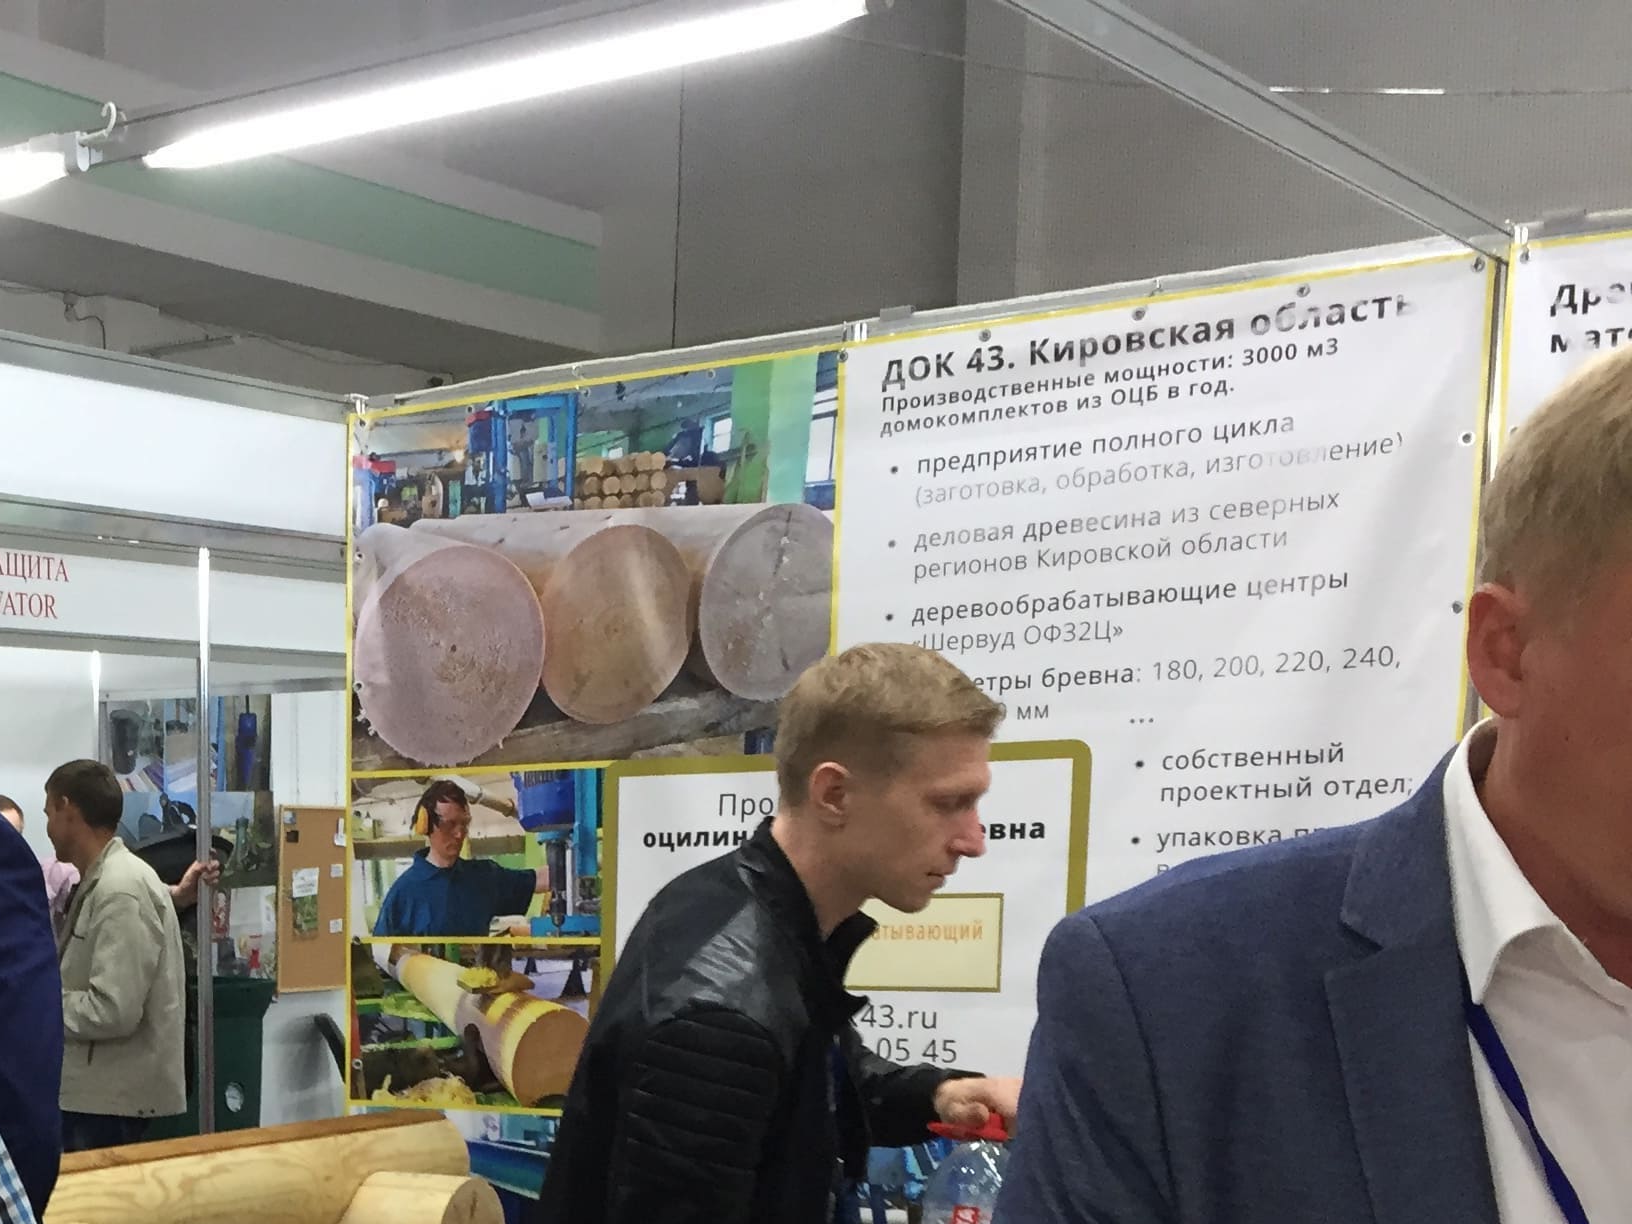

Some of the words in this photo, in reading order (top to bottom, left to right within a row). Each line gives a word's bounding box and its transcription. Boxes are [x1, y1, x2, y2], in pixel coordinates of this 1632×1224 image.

[881, 351, 955, 392] ДОК
[967, 345, 1016, 373] 43.
[1029, 317, 1235, 367] Кировская
[882, 372, 1096, 414] Производственные
[1104, 352, 1233, 384] мощности:
[1241, 343, 1297, 366] 3000
[1306, 337, 1339, 358] м3
[880, 399, 1068, 438] домокомплектов
[1076, 394, 1102, 411] из
[1111, 384, 1159, 407] ОЦБ
[1167, 384, 1180, 400] в
[1189, 379, 1235, 398] год.
[917, 440, 1082, 478] предприятие
[1092, 426, 1203, 455] полного
[1213, 415, 1295, 444] цикла
[915, 477, 1048, 508] (заготовка,
[1056, 460, 1196, 493] обработка,
[913, 524, 1014, 553] деловая
[1022, 509, 1161, 542] древесина
[1171, 506, 1199, 524] из
[1209, 492, 1341, 521] северных
[913, 553, 1028, 583] регионов
[1037, 537, 1172, 571] Кировской
[1181, 530, 1288, 556] области
[911, 581, 1237, 626] деревообрабатывающие
[1247, 572, 1348, 600] центры
[1041, 666, 1142, 693] бревна:
[1152, 658, 1204, 682] 180,
[1213, 654, 1265, 678] 200,
[1275, 650, 1331, 674] 220,
[1342, 645, 1401, 670] 240,
[1017, 704, 1049, 720] мм
[1161, 741, 1345, 771] собственный
[1160, 776, 1312, 807] проектный
[643, 829, 753, 852] оцилин
[979, 822, 1046, 841] вна
[1155, 828, 1282, 852] упаковка
[876, 1036, 910, 1062] 05
[921, 1038, 957, 1064] 45
